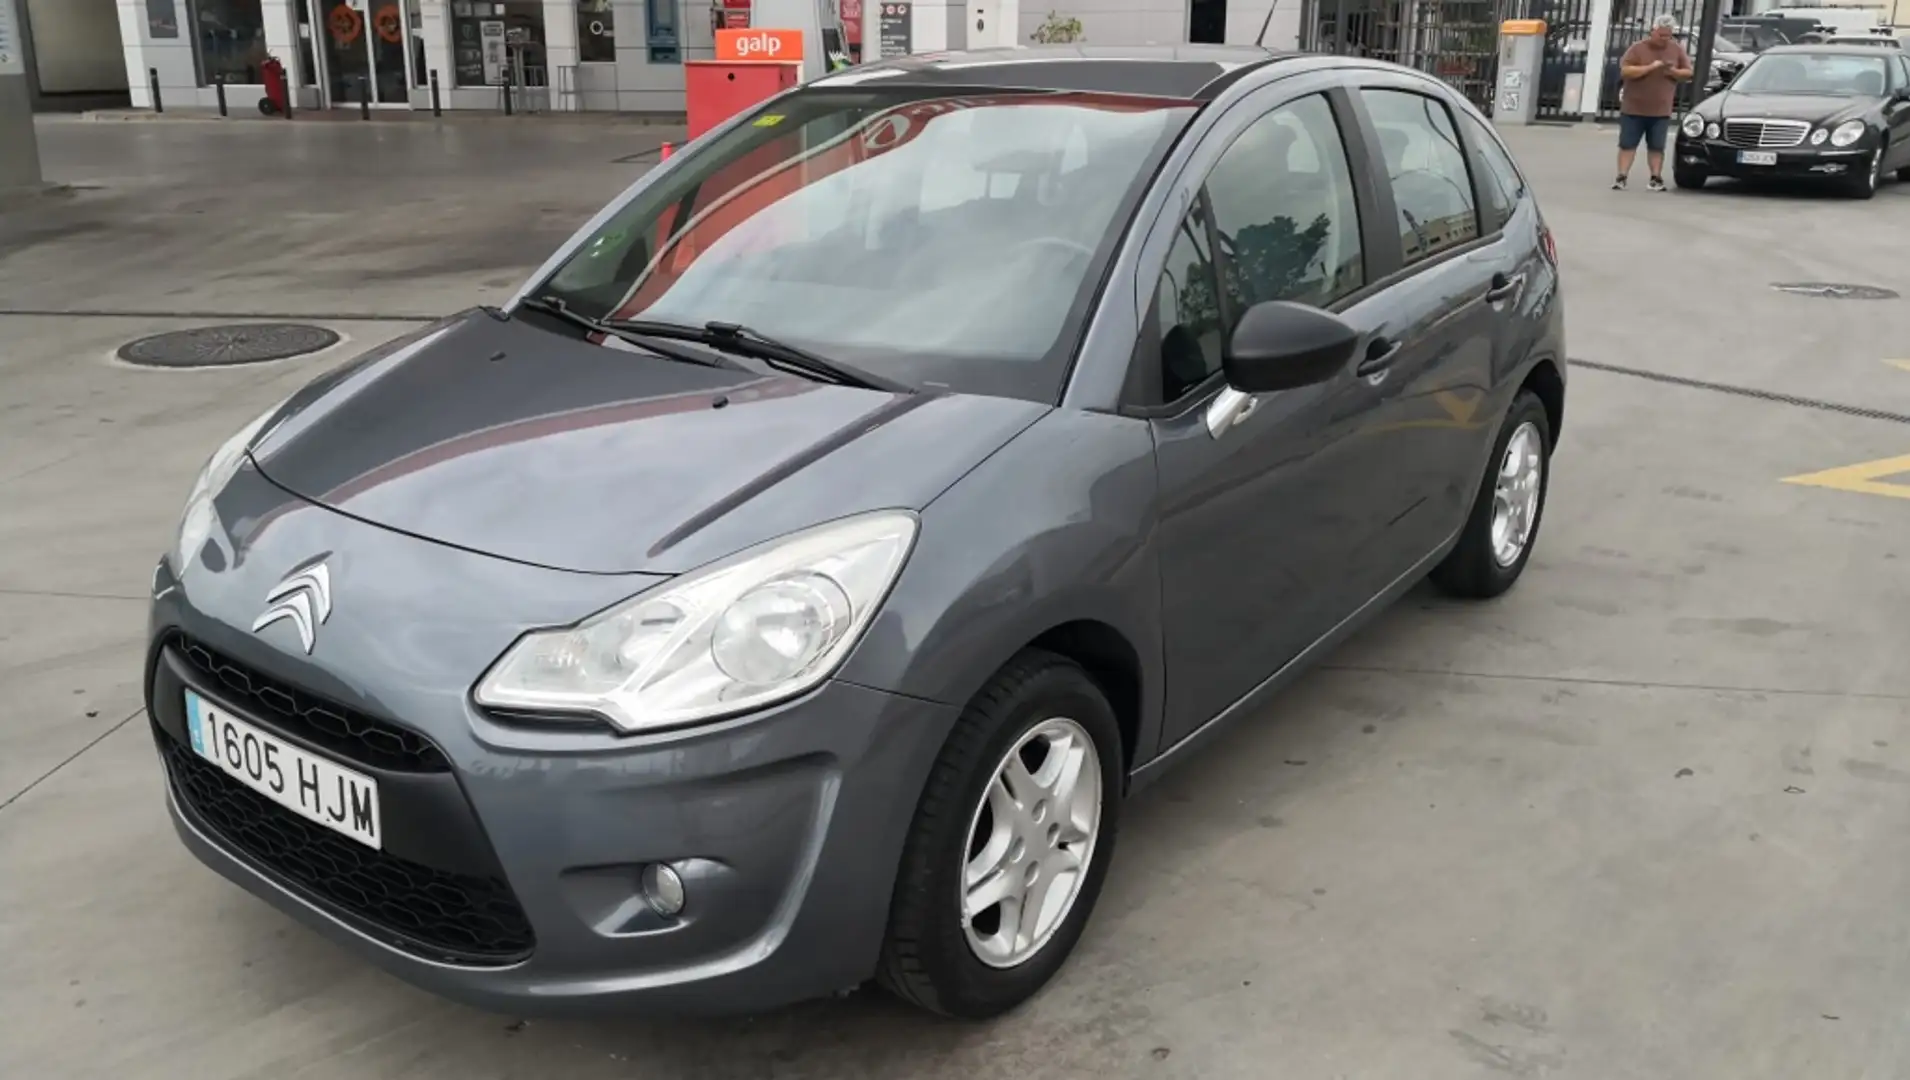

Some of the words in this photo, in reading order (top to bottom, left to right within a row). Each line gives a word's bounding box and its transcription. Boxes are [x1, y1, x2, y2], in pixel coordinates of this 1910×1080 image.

[736, 32, 781, 56] galp
[208, 712, 284, 794] 1605
[298, 757, 374, 838] HJM
